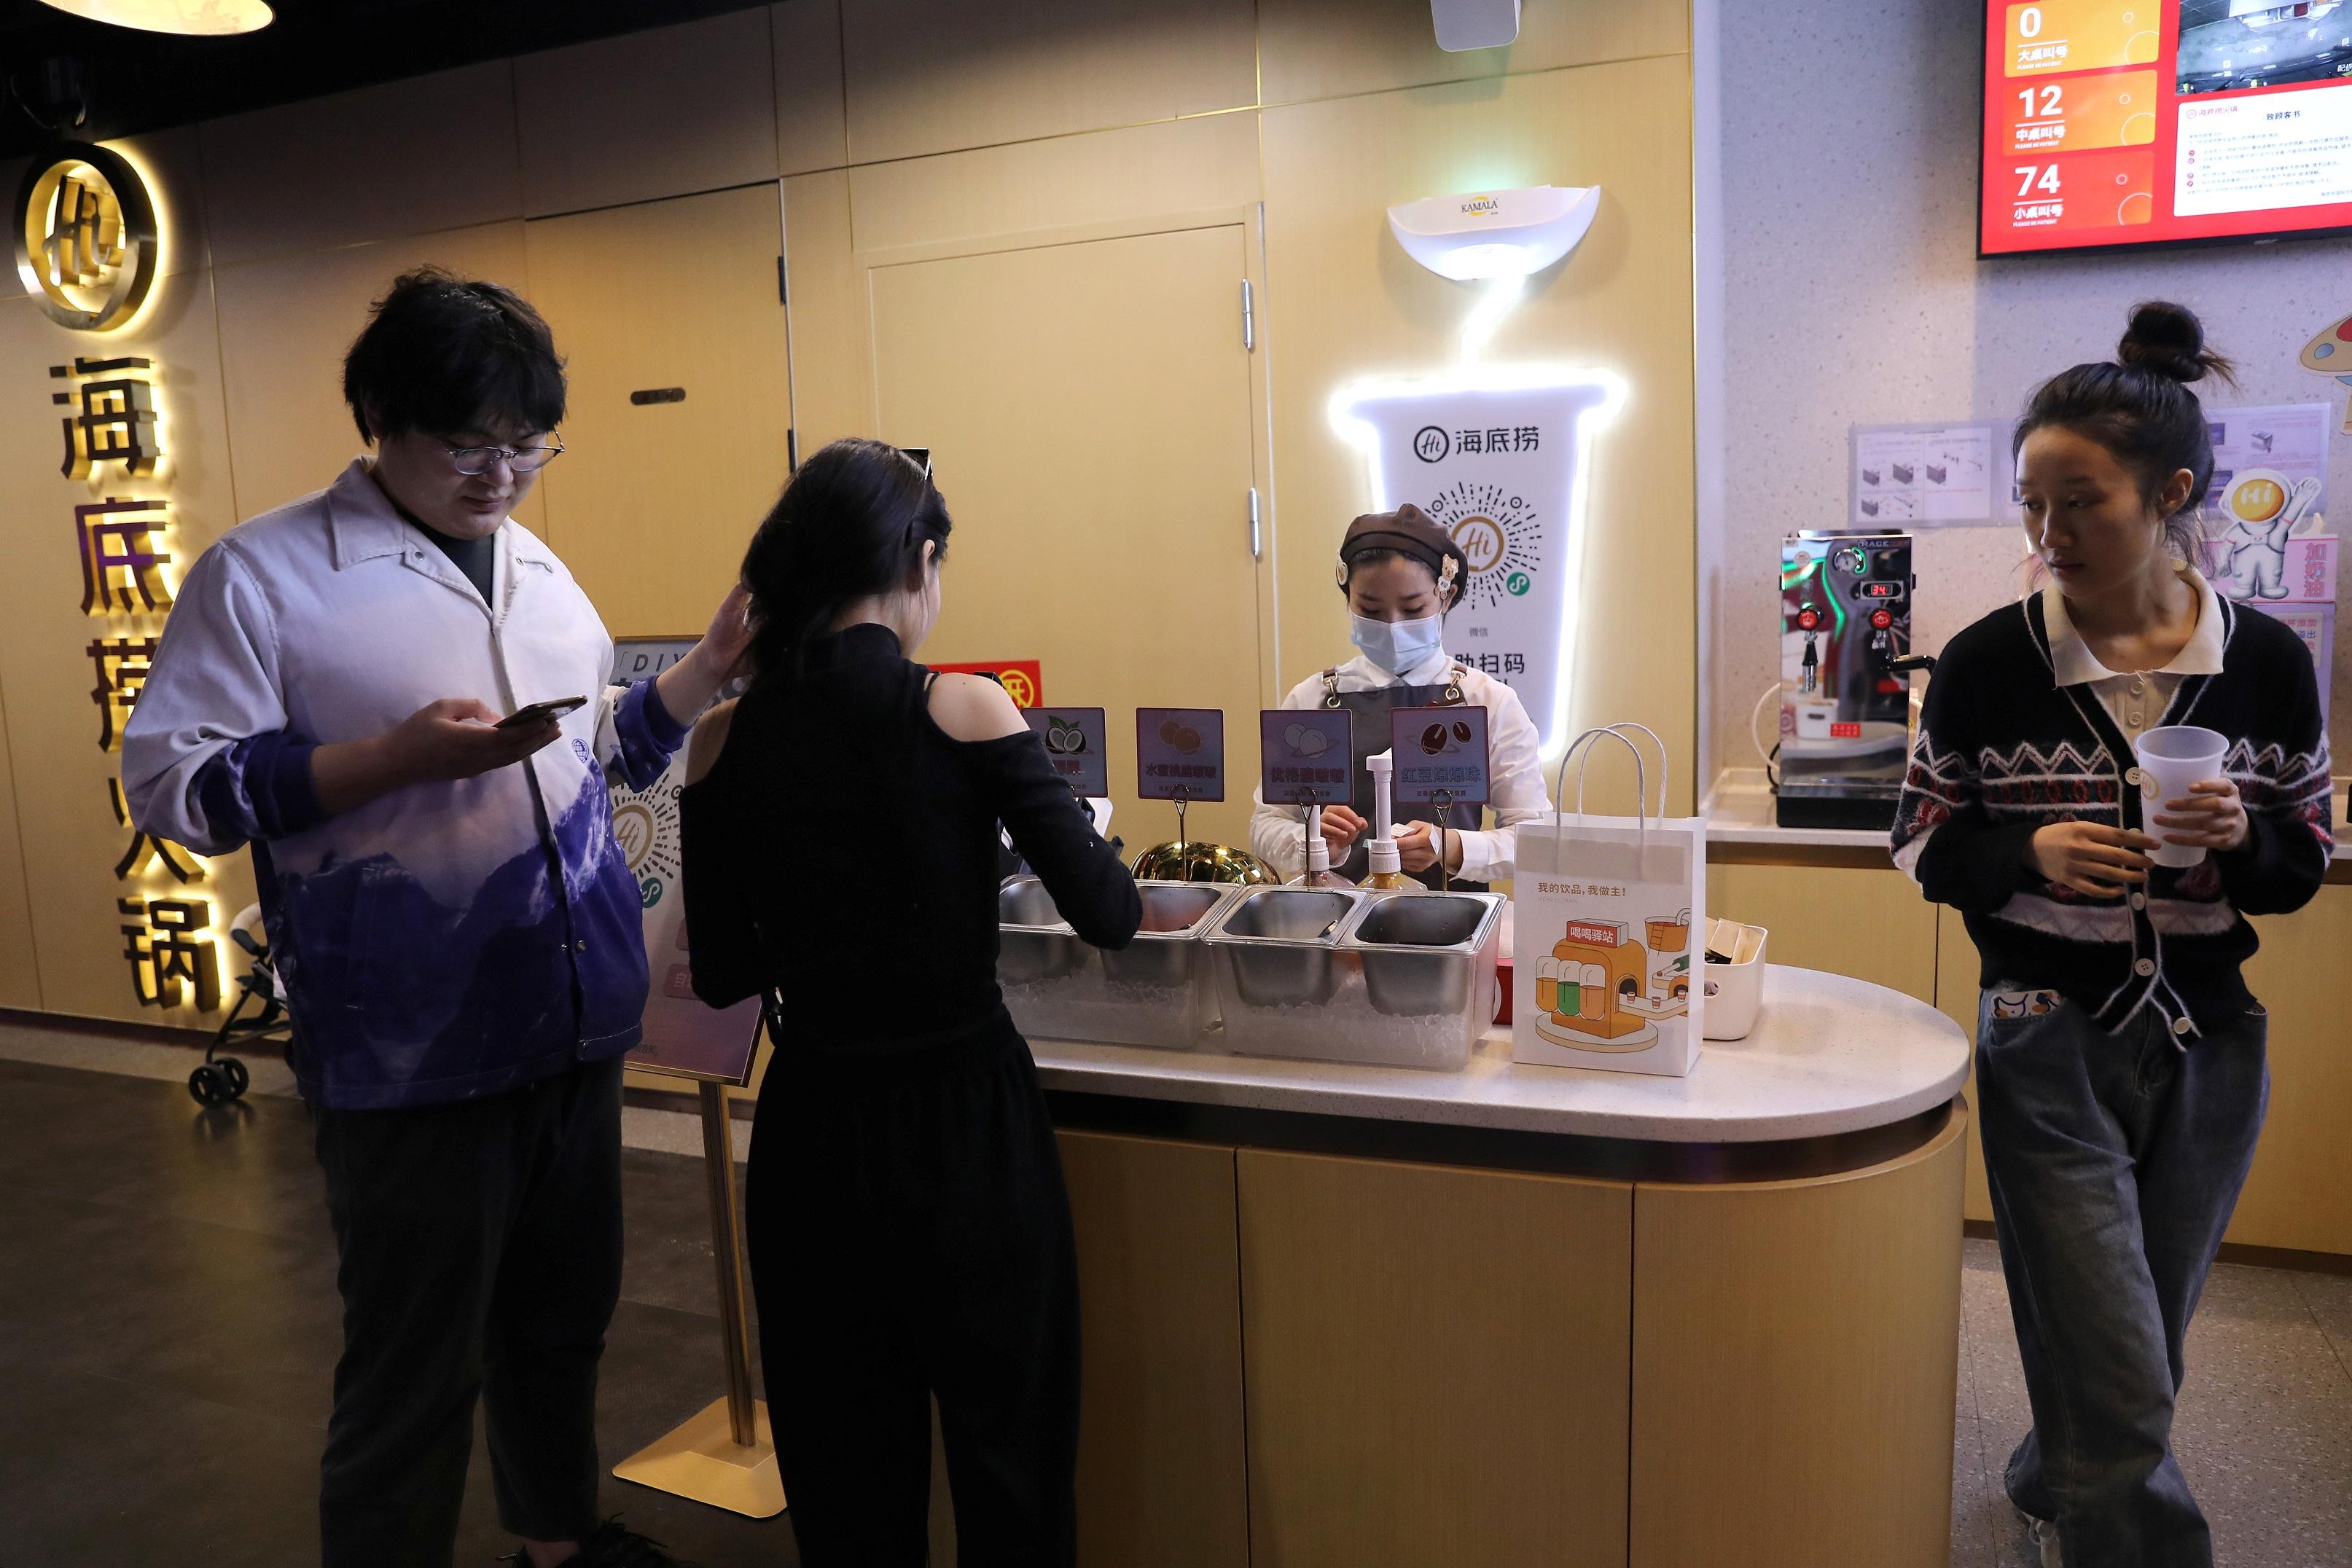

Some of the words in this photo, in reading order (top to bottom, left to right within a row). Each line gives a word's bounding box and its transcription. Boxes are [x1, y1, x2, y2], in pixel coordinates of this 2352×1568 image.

[2019, 7, 2042, 38] 0
[2018, 85, 2063, 117] 12
[2015, 163, 2061, 196] 74
[1461, 200, 1498, 213] KAMALA
[1456, 426, 1539, 455] 海底捞
[2240, 483, 2273, 505] Hi
[1462, 528, 1492, 558] Hi
[1872, 585, 1886, 595] 34
[1570, 926, 1614, 944] 喝喝驿站
